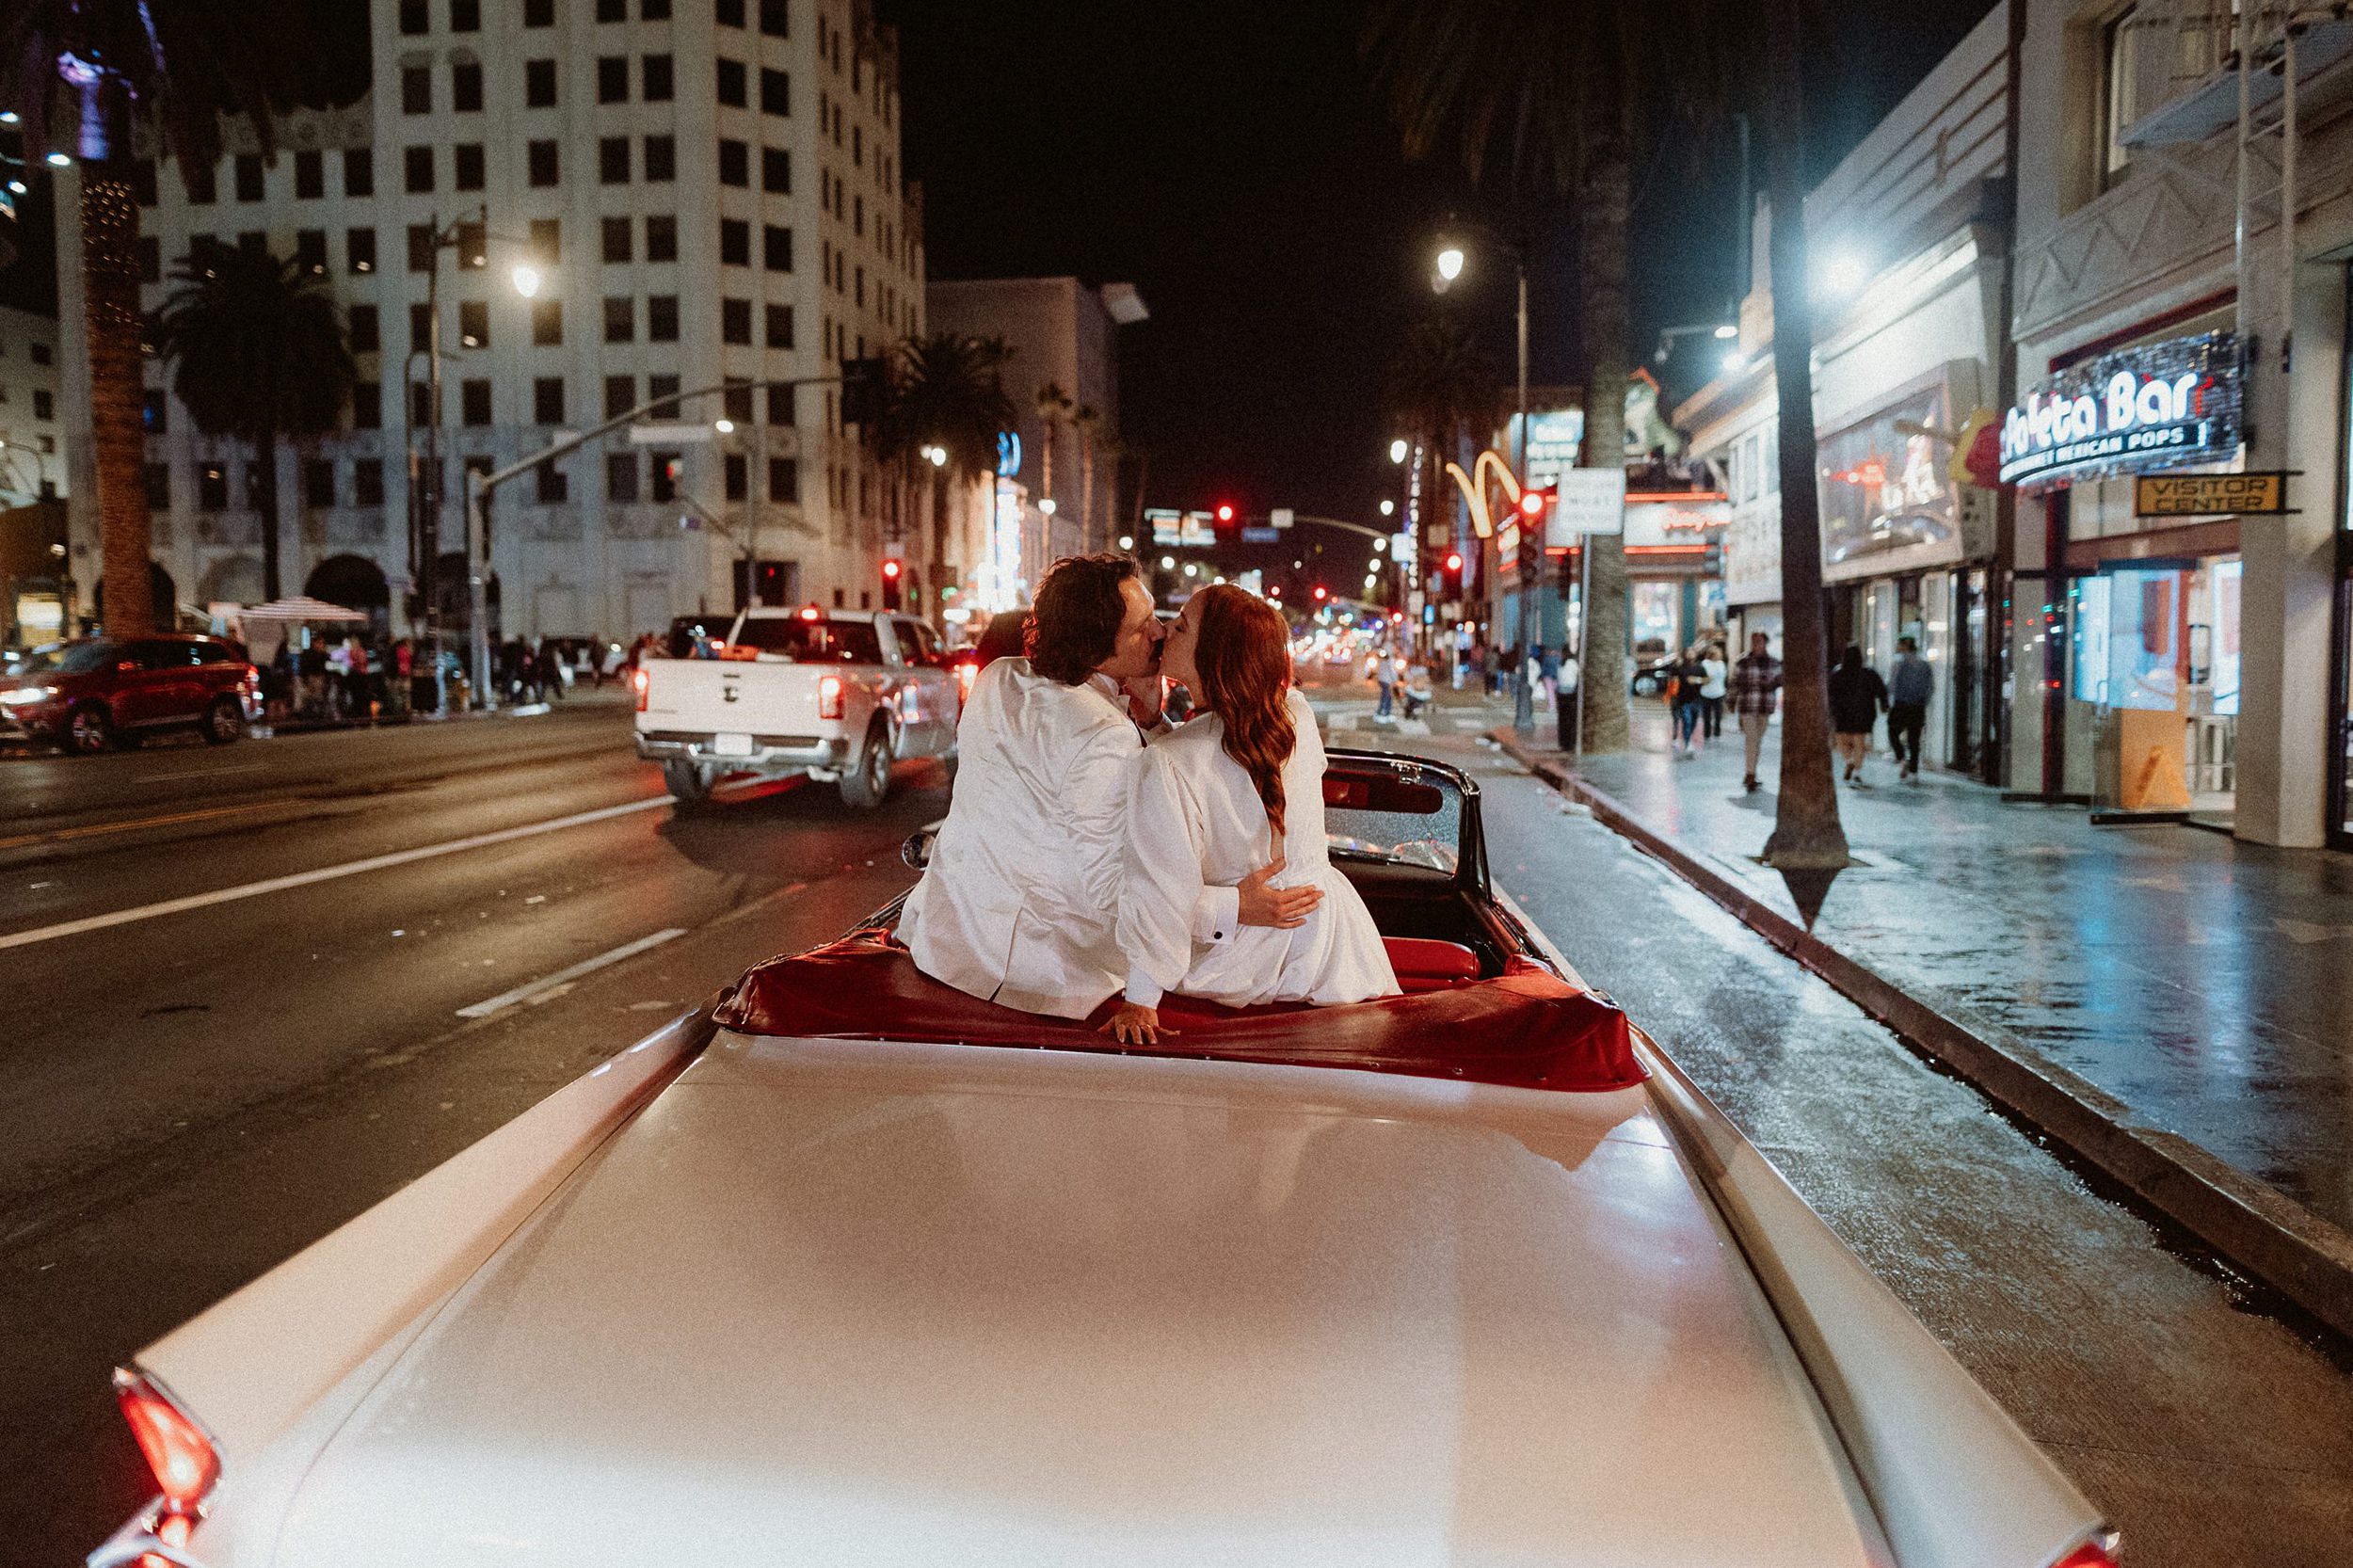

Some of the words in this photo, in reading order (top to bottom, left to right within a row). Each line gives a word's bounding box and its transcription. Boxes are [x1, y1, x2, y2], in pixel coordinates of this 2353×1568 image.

[2107, 371, 2198, 431] Bar
[2128, 426, 2184, 450] POPS
[2152, 478, 2268, 495] VISITOR
[2155, 495, 2264, 513] CENTER
